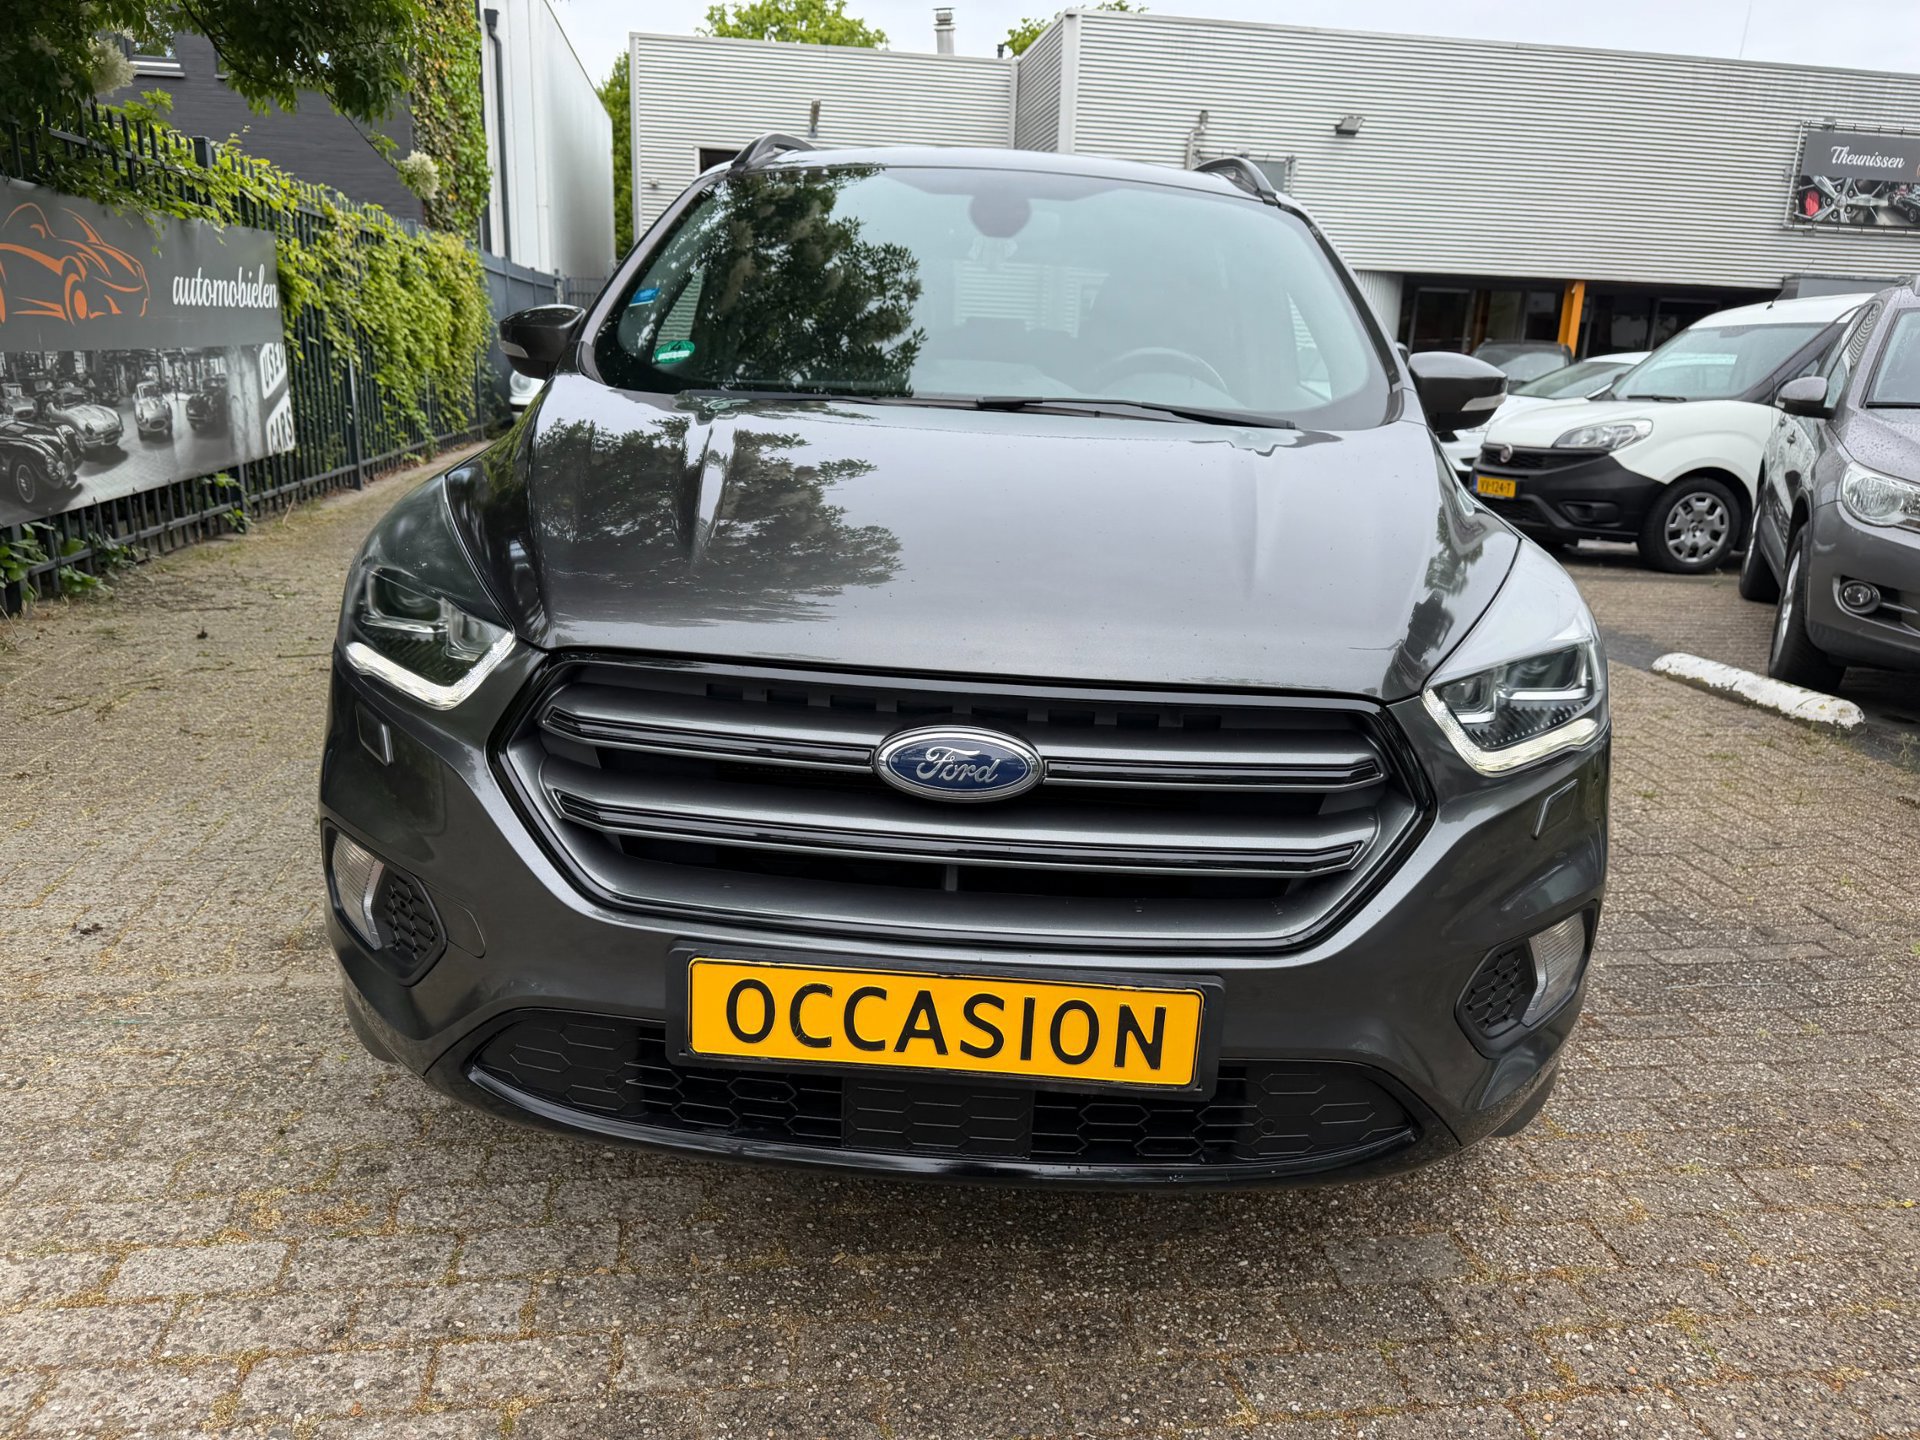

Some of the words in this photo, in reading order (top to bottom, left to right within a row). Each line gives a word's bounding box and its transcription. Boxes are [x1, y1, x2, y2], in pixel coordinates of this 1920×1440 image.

[1830, 146, 1905, 169] Theunissen
[172, 263, 279, 309] automobielen
[269, 405, 293, 452] CARS
[916, 746, 1000, 784] Ford
[725, 978, 1167, 1071] OCCASION
